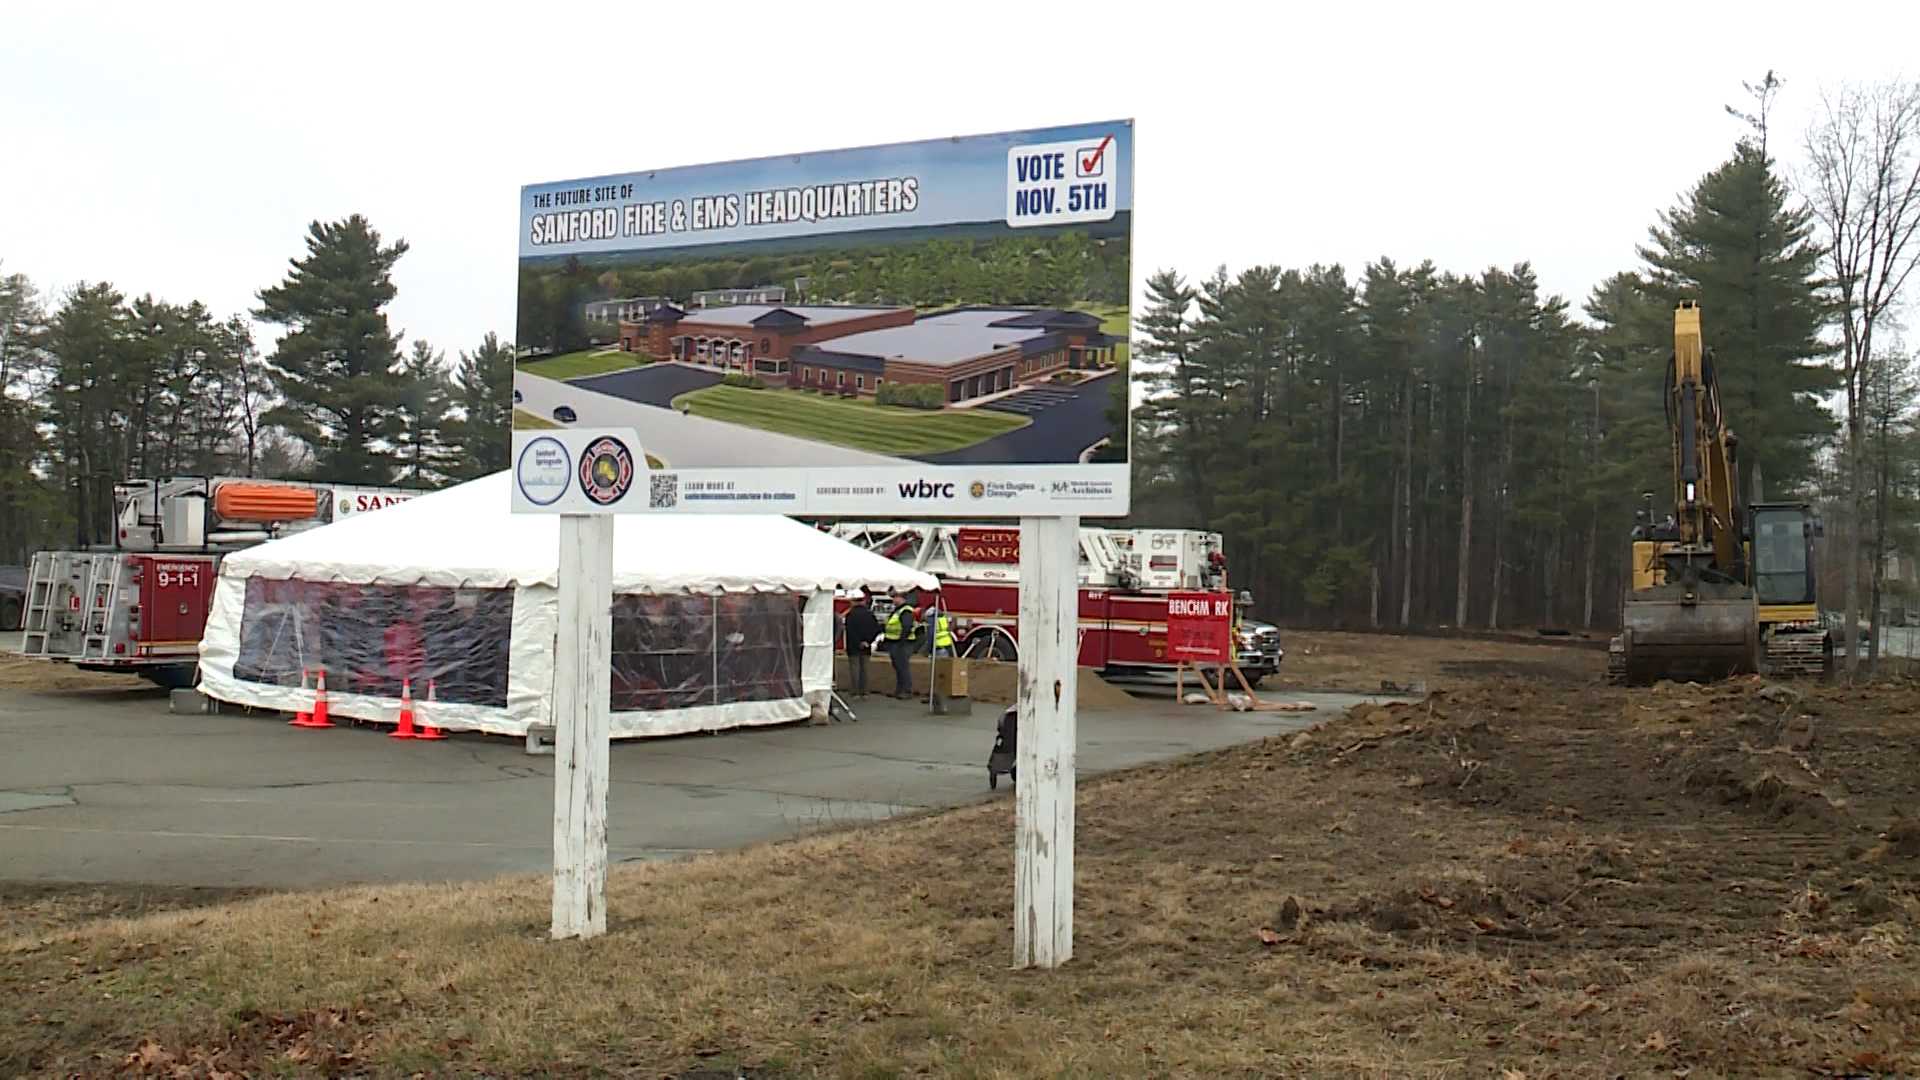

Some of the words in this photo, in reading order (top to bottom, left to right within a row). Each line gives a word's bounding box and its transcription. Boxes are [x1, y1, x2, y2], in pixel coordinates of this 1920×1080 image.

[1016, 153, 1065, 182] VOTE
[534, 193, 551, 208] THE
[555, 188, 591, 206] FUTURE
[595, 186, 617, 202] SITE
[620, 183, 634, 199] OF
[1016, 187, 1062, 216] NOV.
[1068, 182, 1107, 212] 5TH
[530, 207, 618, 246] SANFORD
[623, 202, 666, 237] FIRE
[671, 199, 687, 232] &
[691, 193, 740, 231] EMS
[744, 176, 919, 226] HEADQUARTERS
[898, 479, 955, 498] wbrc
[986, 481, 1005, 490] Five
[1006, 481, 1035, 491] Bugles
[986, 490, 1017, 498] Design
[356, 495, 412, 512] SAN
[981, 533, 1016, 542] CITY
[156, 563, 200, 572] EMERGENCY
[158, 571, 199, 587] 9-1-1
[1168, 599, 1229, 616] BENCHMRK
